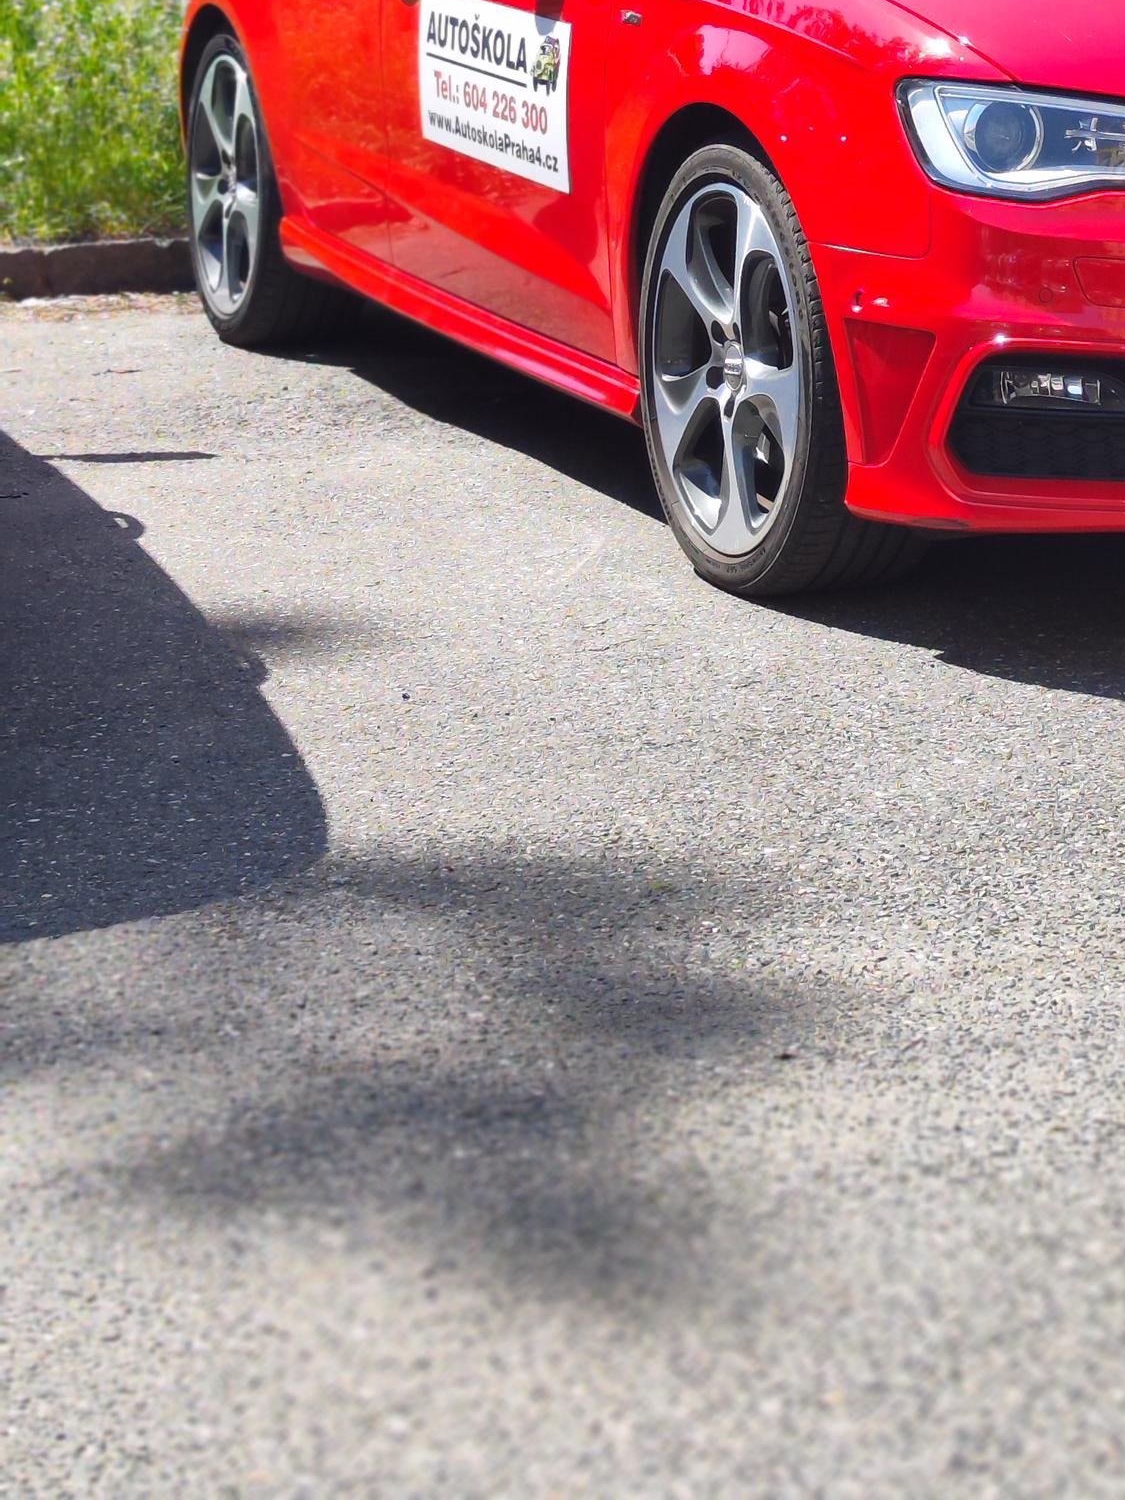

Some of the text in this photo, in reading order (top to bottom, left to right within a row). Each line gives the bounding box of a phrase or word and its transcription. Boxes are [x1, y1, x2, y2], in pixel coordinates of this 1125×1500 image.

[427, 11, 528, 73] AUTOŠKOLA
[434, 70, 548, 135] Tel.: 604 226 300
[428, 110, 559, 173] www.AutoskolaPraha4.cz
